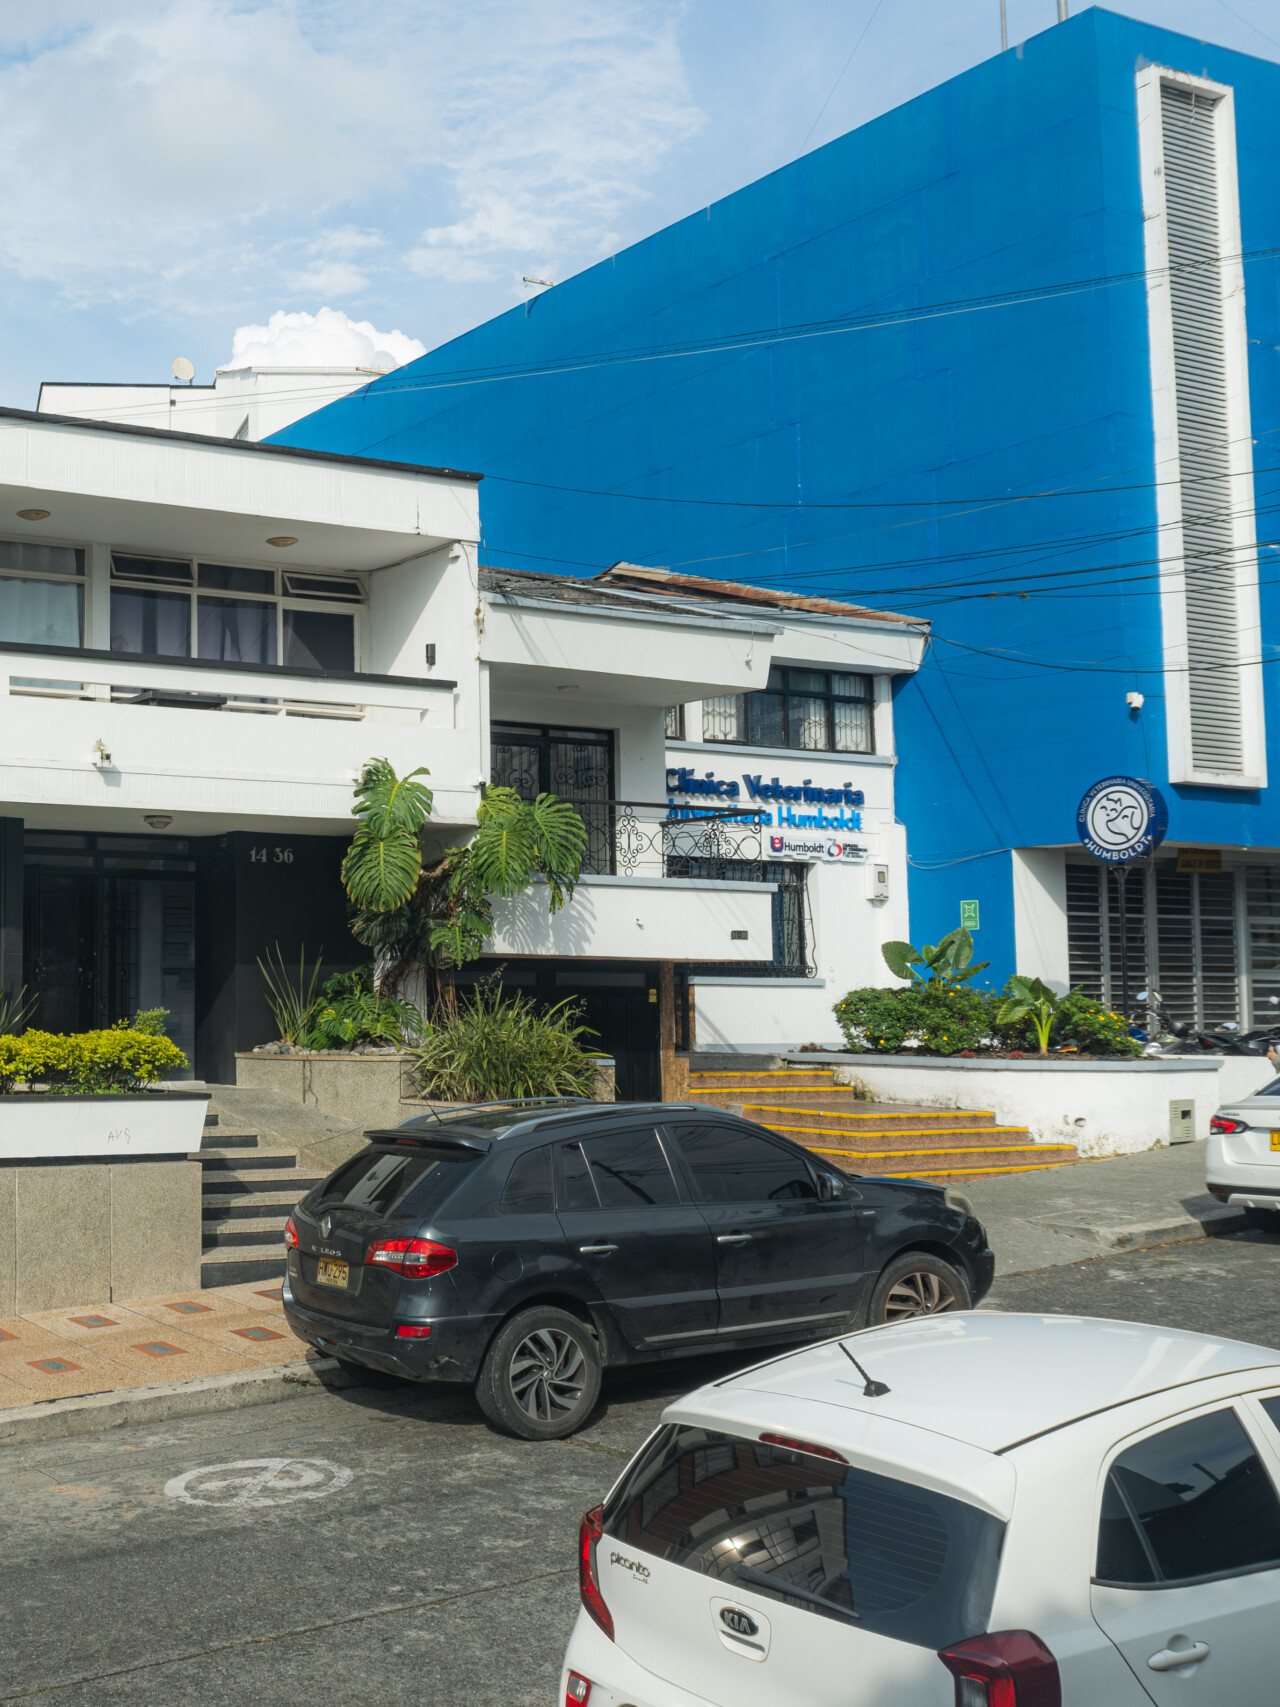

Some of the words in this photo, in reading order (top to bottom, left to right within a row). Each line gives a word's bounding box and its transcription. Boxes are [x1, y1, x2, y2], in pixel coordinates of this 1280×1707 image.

[742, 774, 864, 805] Veterinaria
[1089, 778, 1126, 797] VETERINARIA
[778, 806, 863, 831] Humboldt
[249, 846, 267, 862] 14
[273, 847, 294, 863] 36
[784, 841, 825, 854] Humboldt
[1086, 836, 1149, 860] HUMBOLDT
[610, 1551, 651, 1578] picanto
[723, 1610, 752, 1634] KIA
